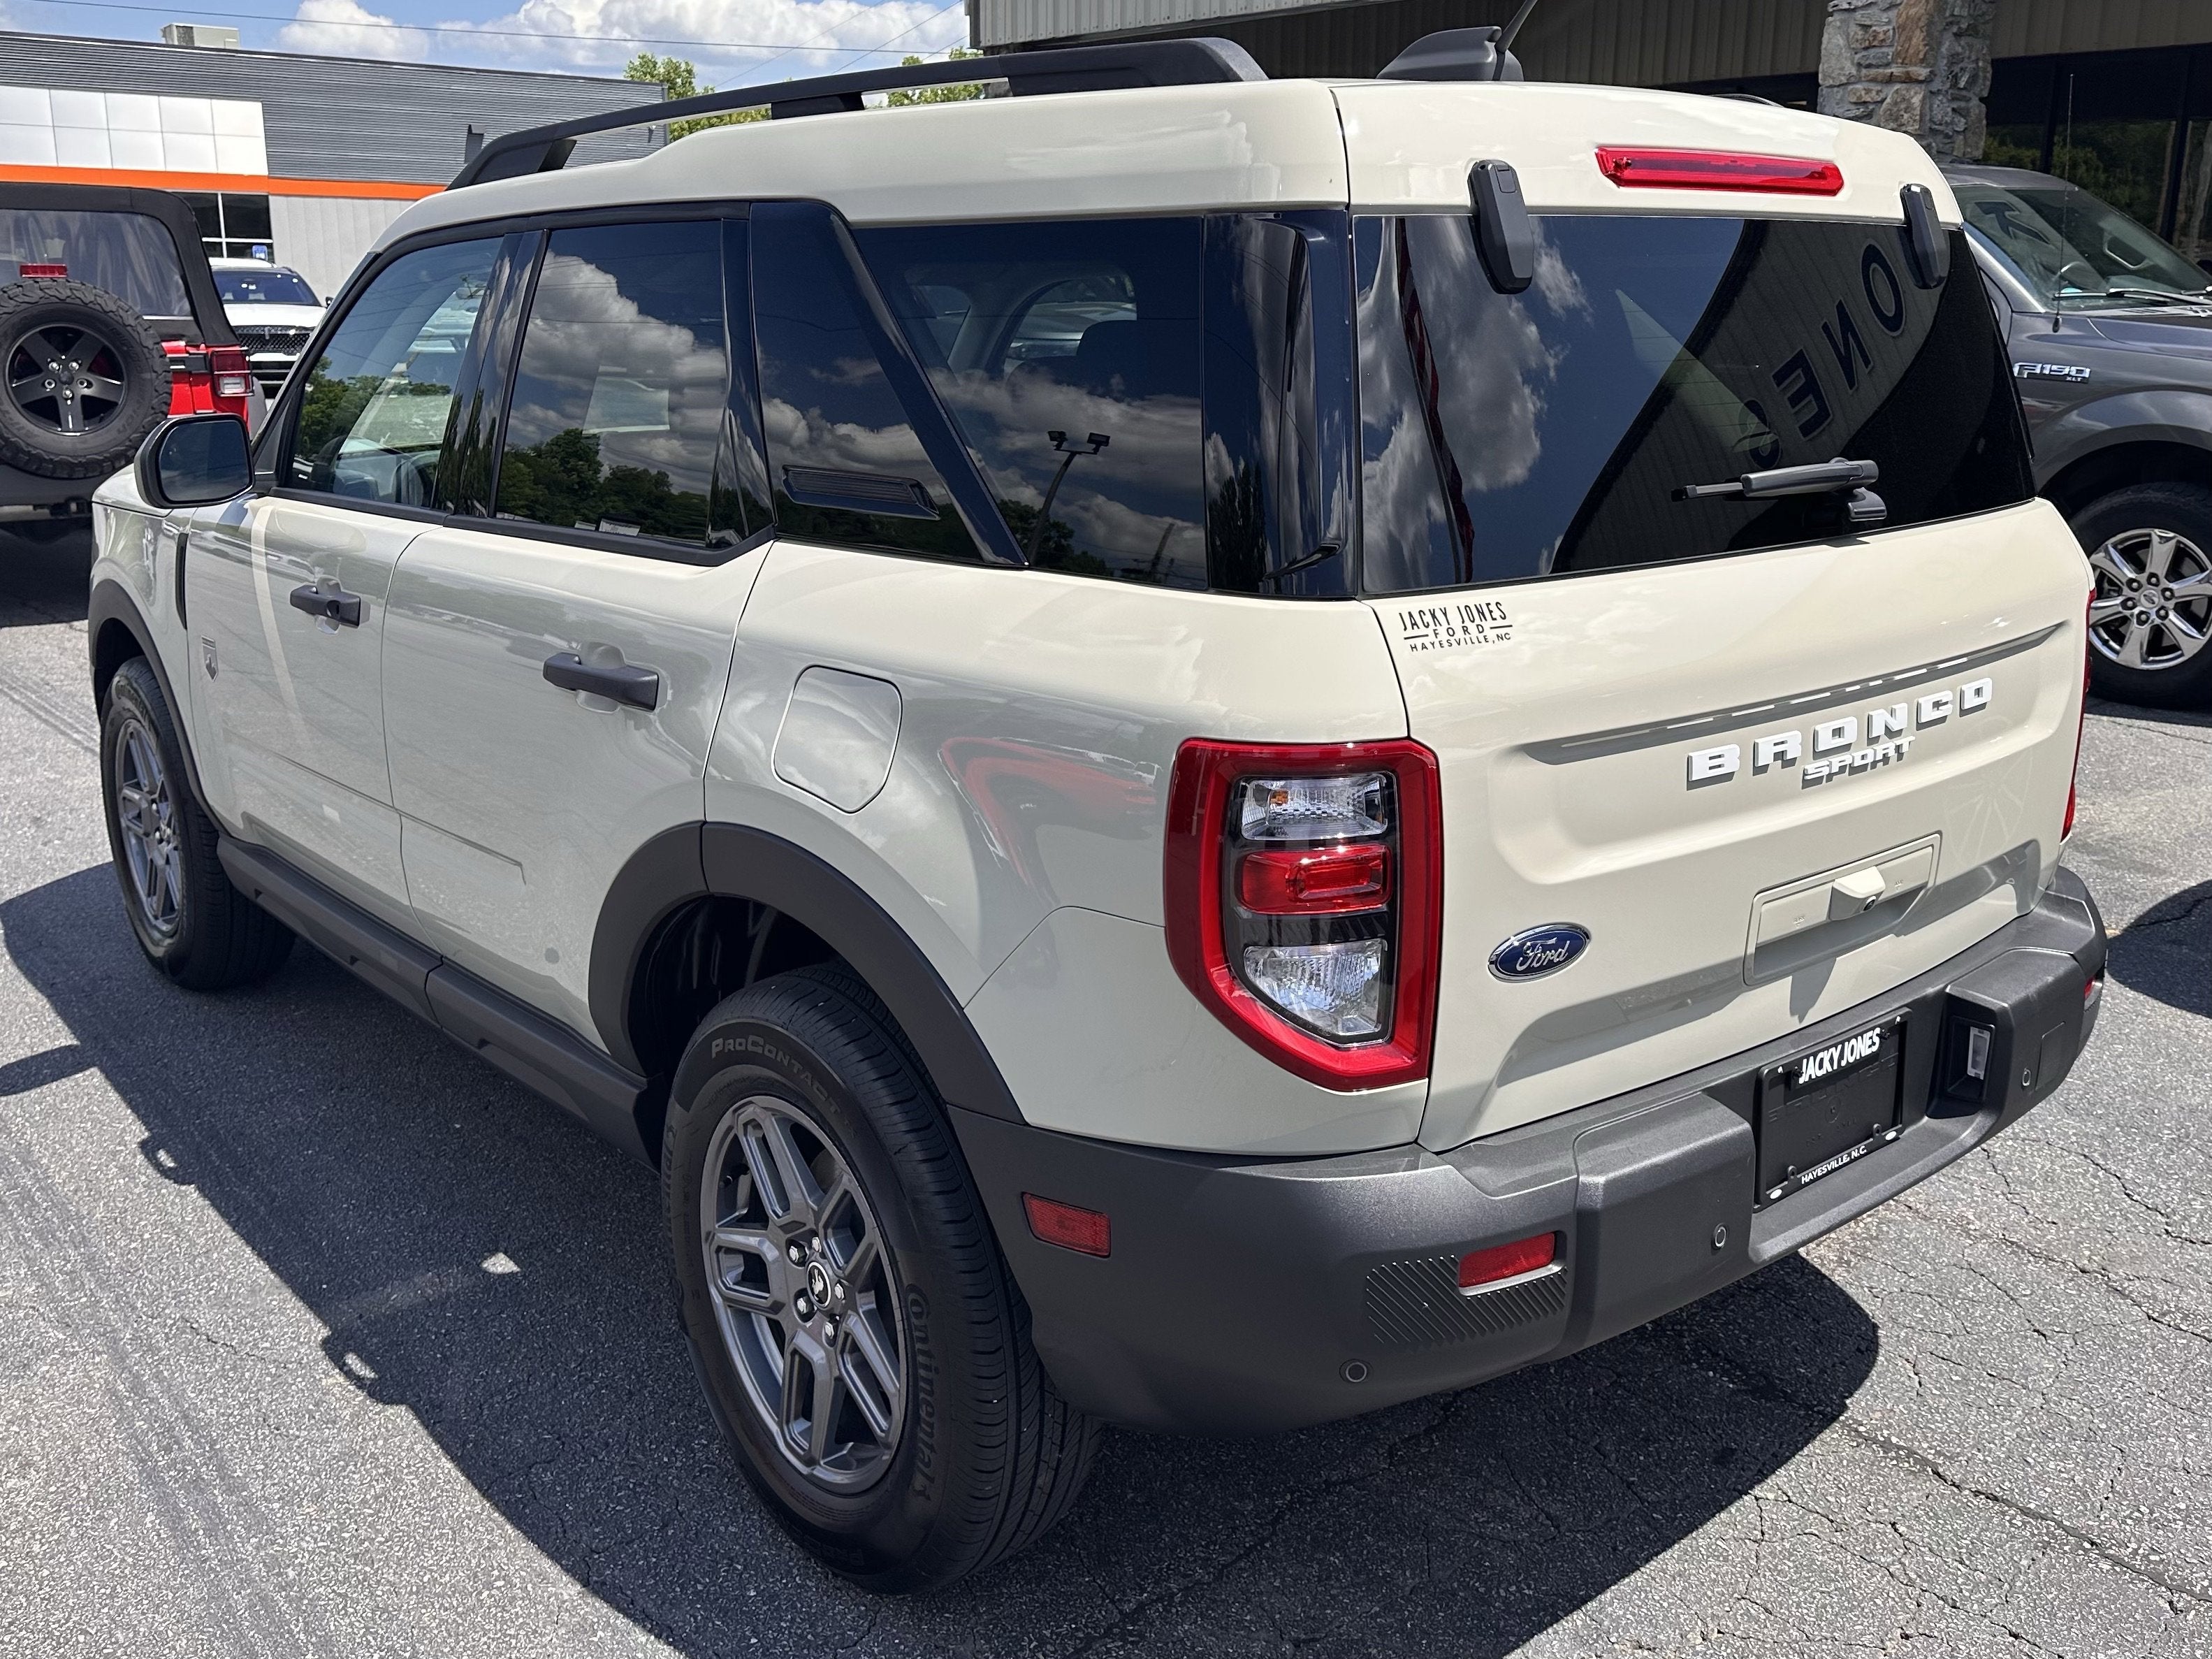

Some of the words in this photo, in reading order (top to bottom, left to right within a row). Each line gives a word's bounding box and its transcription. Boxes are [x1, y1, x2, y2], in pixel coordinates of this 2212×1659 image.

[1399, 607, 1451, 631] JACKY
[1457, 602, 1507, 624] JONES
[1433, 623, 1485, 639] FORD
[1687, 677, 1993, 781] BRONCO
[1804, 736, 1916, 780] SPORT
[1515, 936, 1571, 971] Ford
[1798, 1044, 1842, 1084] JACKY
[1841, 1027, 1881, 1066] JONES
[905, 1283, 936, 1484] Continental
